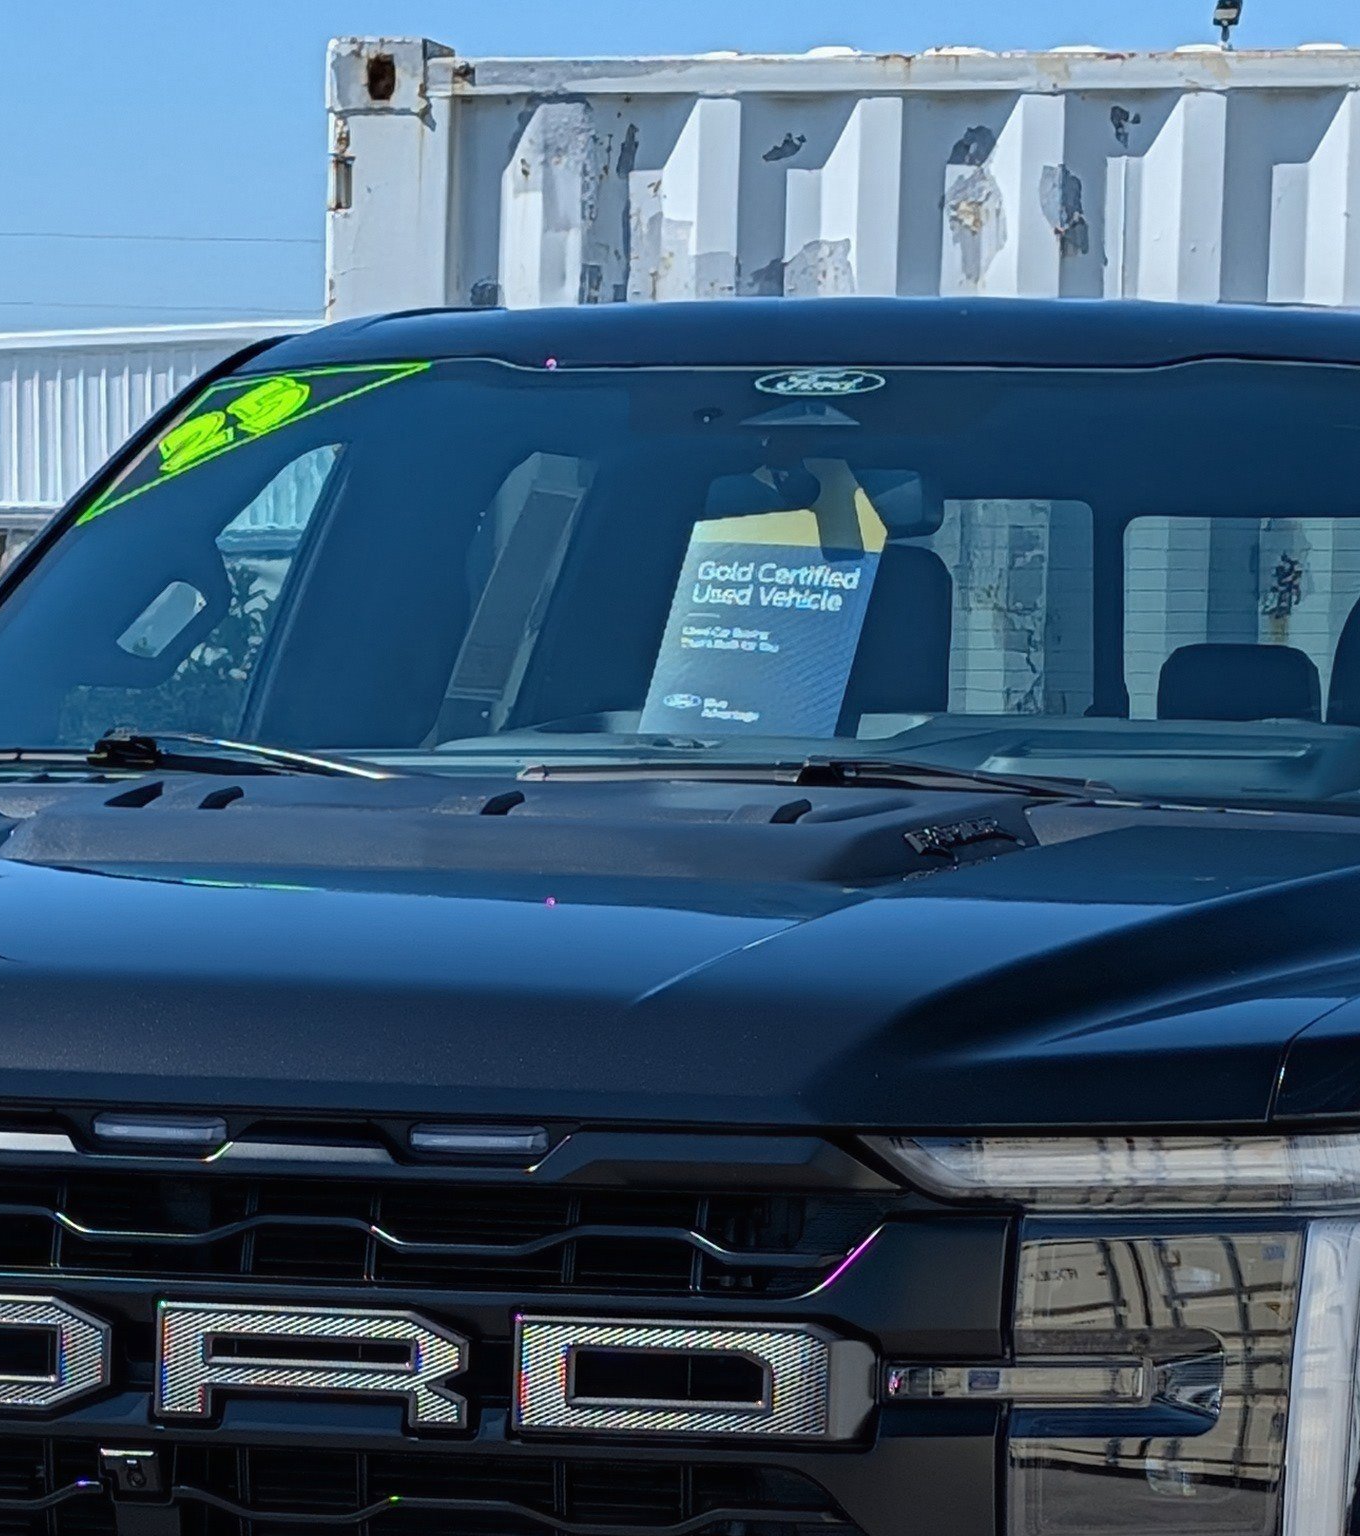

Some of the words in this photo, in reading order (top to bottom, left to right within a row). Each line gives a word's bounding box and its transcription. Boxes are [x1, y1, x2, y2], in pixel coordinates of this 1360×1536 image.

[775, 371, 864, 391] Ford
[698, 561, 754, 582] Gold
[758, 563, 861, 590] Certified
[692, 583, 753, 606] Used
[759, 586, 842, 612] Vehicle
